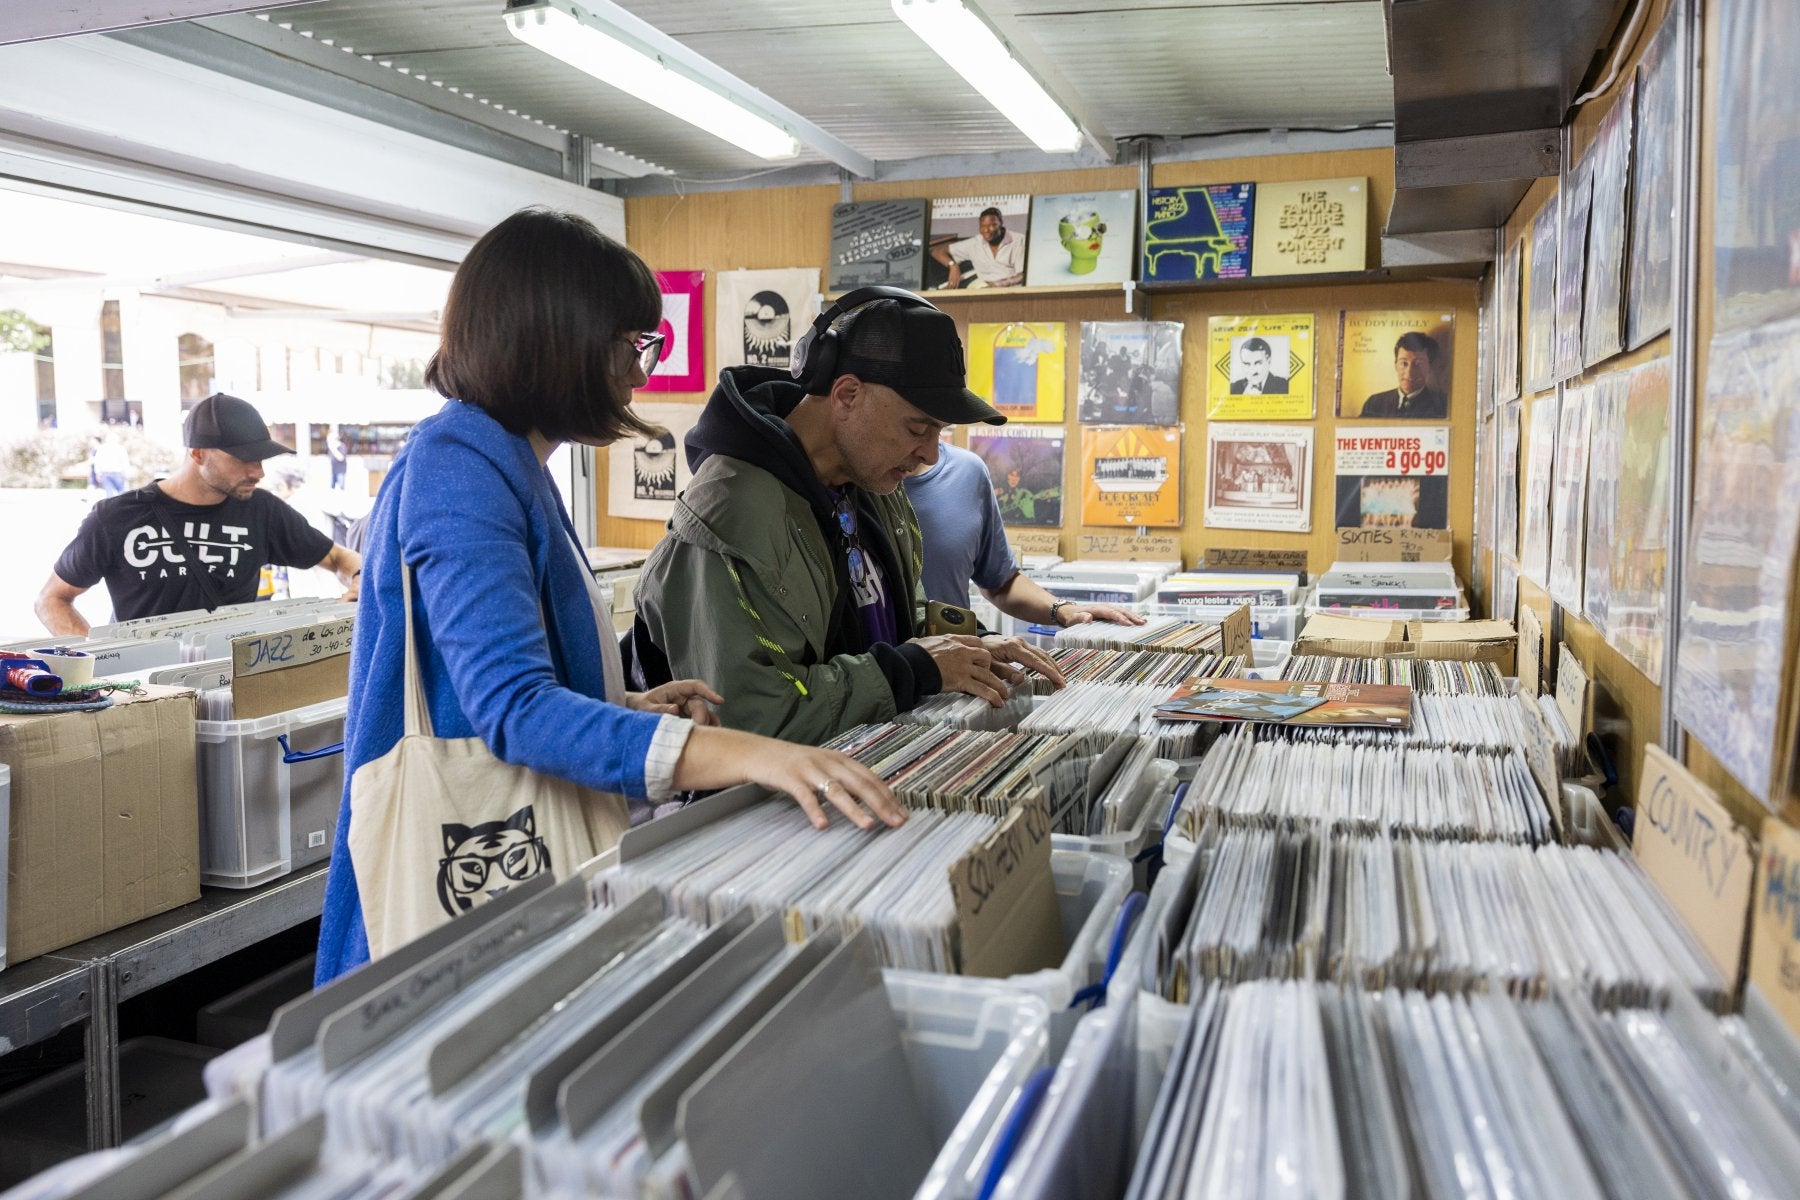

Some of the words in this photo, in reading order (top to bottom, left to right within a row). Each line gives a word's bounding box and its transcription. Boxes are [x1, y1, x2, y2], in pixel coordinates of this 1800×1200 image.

[1299, 190, 1327, 203] THE
[1283, 202, 1342, 215] FAMOUS
[1279, 213, 1344, 229] ESQUIRE
[1277, 238, 1344, 253] CONCERT
[1337, 438, 1357, 451] THE
[1360, 437, 1421, 451] VENTURES
[1386, 450, 1396, 469] a
[1400, 450, 1446, 475] go-go
[123, 521, 249, 568] CULT
[1081, 536, 1119, 553] JAZZ
[1123, 536, 1134, 545] de
[1341, 529, 1393, 545] SIXTIES
[1209, 549, 1250, 566] JAZZ
[1252, 550, 1265, 559] de
[139, 564, 235, 581] TARFA
[1177, 596, 1203, 606] young
[1204, 595, 1229, 605] lester
[1230, 595, 1257, 606] young
[245, 634, 295, 668] JAZZ
[302, 626, 317, 642] de
[320, 624, 334, 638] los
[336, 619, 353, 635] año
